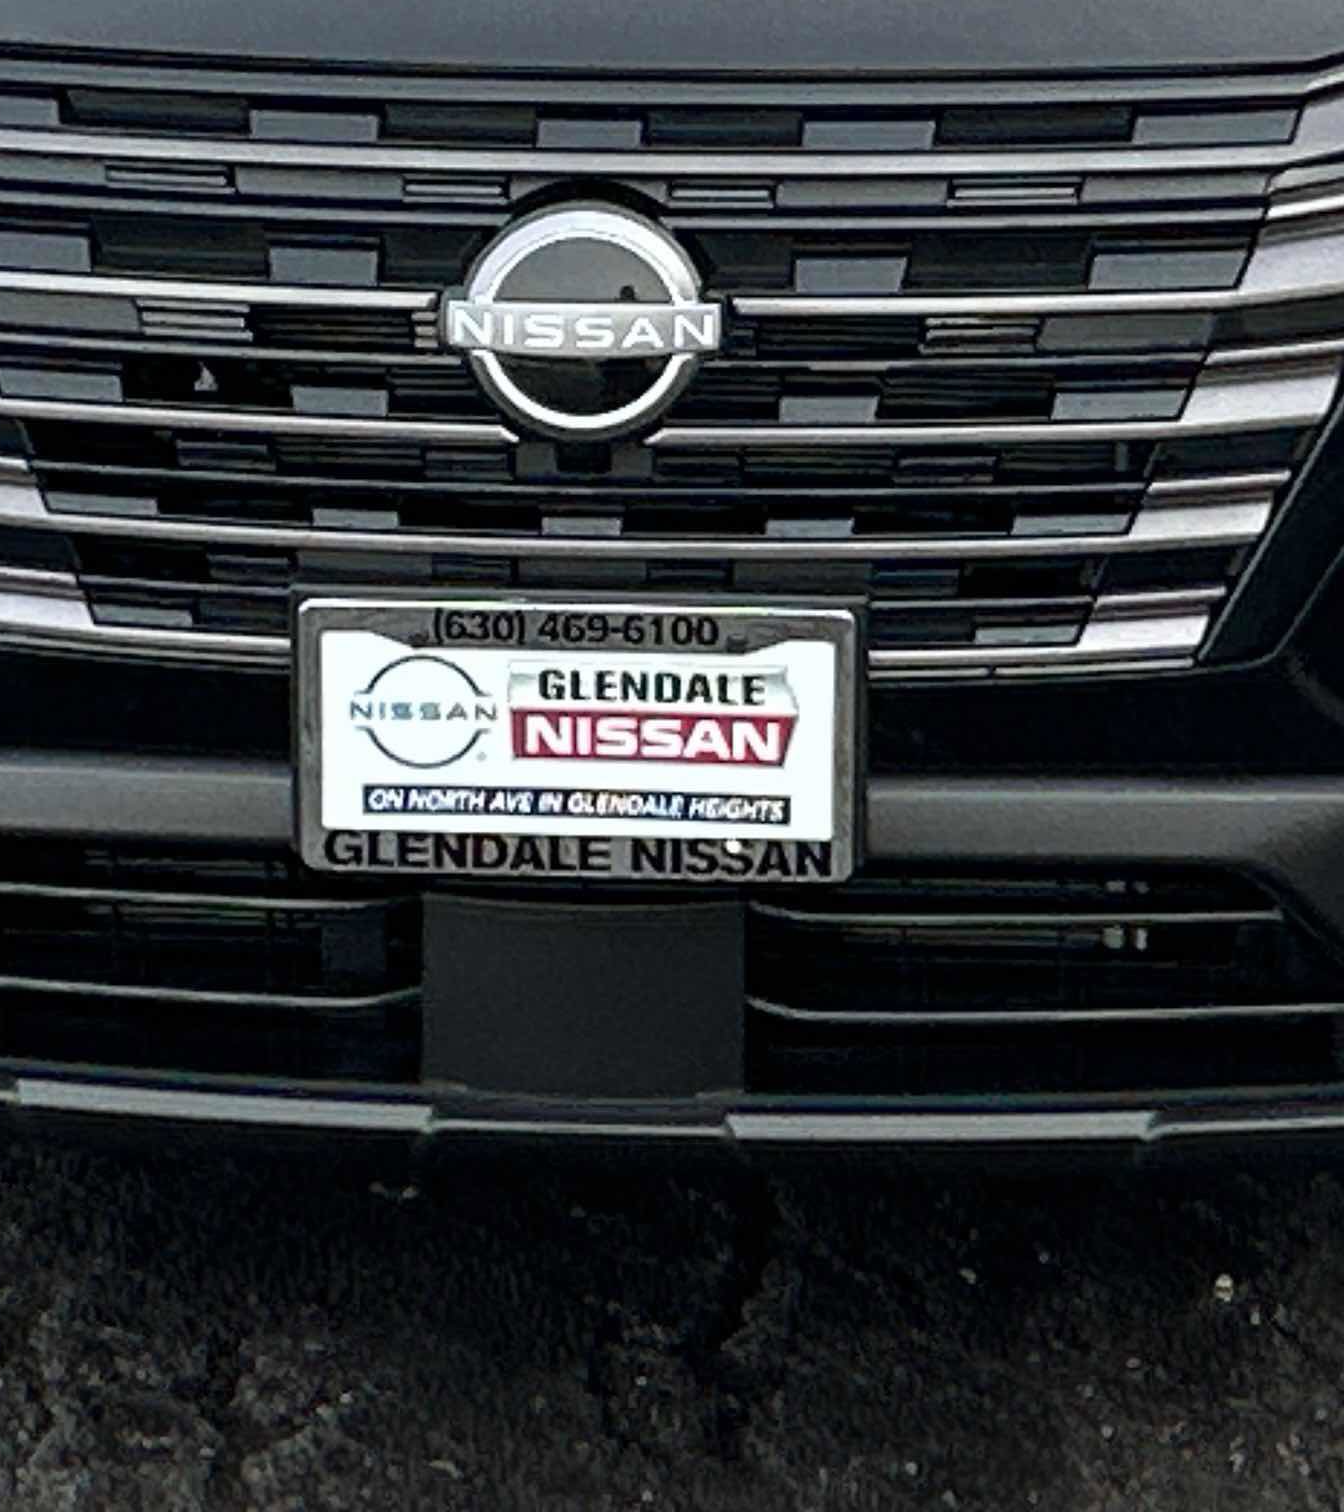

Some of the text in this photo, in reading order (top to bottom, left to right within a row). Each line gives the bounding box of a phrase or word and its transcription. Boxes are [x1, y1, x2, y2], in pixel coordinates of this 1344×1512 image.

[453, 308, 714, 349] NISSAN
[432, 607, 720, 646] (630) 469-6100
[538, 668, 766, 706] GLENDALE
[350, 701, 498, 721] NISSAN
[524, 713, 782, 762] NISSAN
[368, 788, 786, 823] ON NORTH AVE IN GLENDALE HEIGHTS
[323, 829, 832, 877] GLENDALE NISSAN
